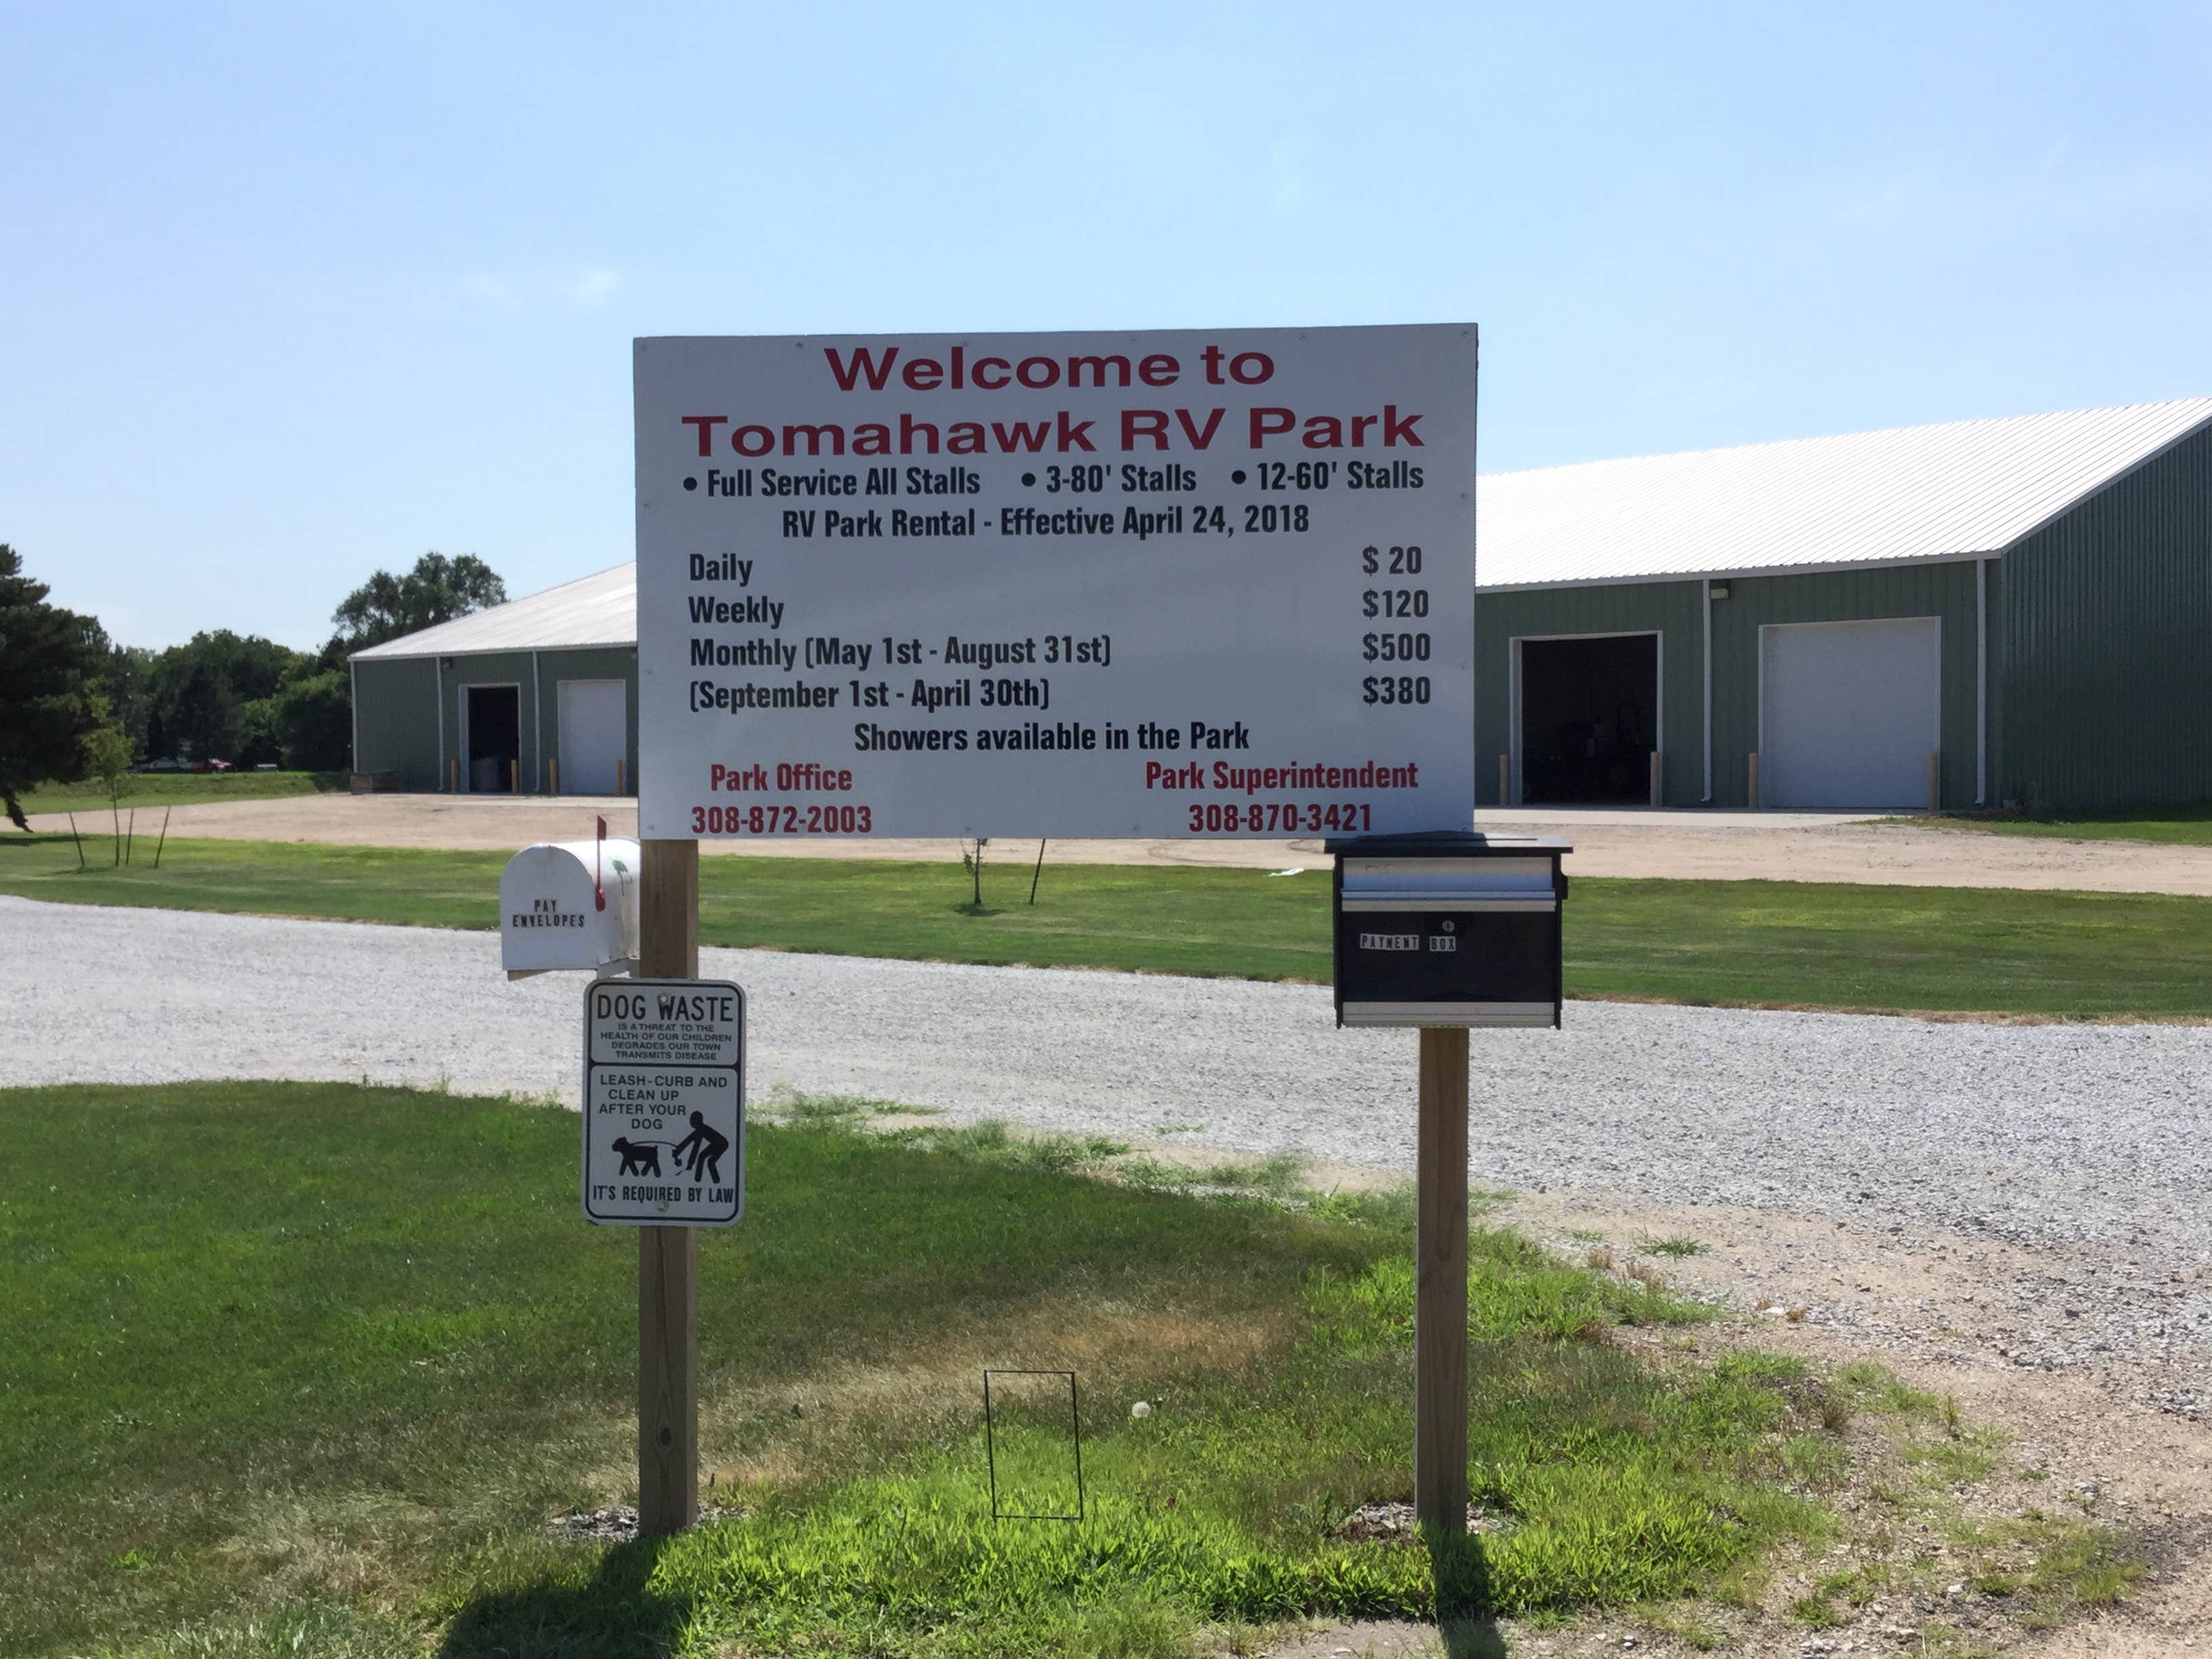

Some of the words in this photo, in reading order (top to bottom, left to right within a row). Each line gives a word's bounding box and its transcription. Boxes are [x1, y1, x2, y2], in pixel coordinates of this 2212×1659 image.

[824, 346, 1180, 391] Welcome
[1200, 346, 1274, 384] to
[682, 411, 1097, 457] Tomahawk
[1122, 409, 1225, 451] RV
[1250, 405, 1425, 449] Park
[708, 470, 752, 497] Full
[762, 469, 857, 496] Service
[865, 468, 897, 495] All
[907, 467, 980, 495] Stalls
[1046, 465, 1111, 493] 3-80'
[1122, 464, 1196, 491] Stalls
[1258, 462, 1336, 490] 12-60'
[1348, 461, 1423, 489] Stalls
[783, 510, 815, 537] RV
[825, 510, 882, 537] Park
[893, 508, 975, 536] Rental
[1001, 507, 1114, 535] Effective
[1123, 506, 1182, 540] April
[1193, 506, 1233, 537] 24,
[1245, 505, 1309, 532] 2018
[690, 553, 752, 587] Daily
[689, 596, 784, 629] Weekly
[1363, 589, 1428, 619] $120
[691, 638, 797, 672] Monthly
[806, 638, 872, 671] (May
[882, 638, 922, 664] 1st
[945, 636, 1036, 670] August
[1045, 635, 1110, 667] 31st)
[1363, 632, 1430, 663] $500
[691, 680, 839, 714] (September
[849, 680, 888, 707] 1st
[912, 679, 970, 713] April
[981, 678, 1048, 710] 30th)
[1363, 676, 1430, 706] $380
[855, 723, 968, 750] Showers
[977, 722, 1095, 750] available
[1106, 722, 1128, 749] in
[1137, 722, 1179, 750] the
[1191, 722, 1249, 749] Park
[712, 764, 768, 791] Park
[777, 764, 852, 791] Office
[1147, 762, 1204, 789] Park
[1214, 760, 1418, 795] Superintendent
[692, 806, 871, 834] 308-872-2003
[1189, 804, 1370, 832] 308-870-3421
[534, 900, 557, 912] PAY
[513, 916, 585, 927] ENVELOPES
[1361, 935, 1418, 949] PAYMENT
[1431, 937, 1455, 950] BOX
[597, 994, 646, 1019] DOG
[657, 996, 733, 1022] WASTE
[611, 1042, 665, 1050] DEGRADES
[615, 1051, 672, 1059] TRANSMITS
[675, 1052, 716, 1060] DISEASE
[600, 1075, 645, 1086] LEASH
[655, 1076, 693, 1086] CURB
[698, 1077, 727, 1088] AND
[608, 1089, 655, 1100] CLEAN
[661, 1090, 679, 1101] UP
[599, 1103, 644, 1115] AFTER
[649, 1104, 686, 1115] YOUR
[632, 1119, 663, 1130] DOG
[593, 1185, 615, 1200] IT'S
[623, 1187, 681, 1204] REQUIRED
[688, 1188, 702, 1202] BY
[709, 1189, 733, 1203] LAW
